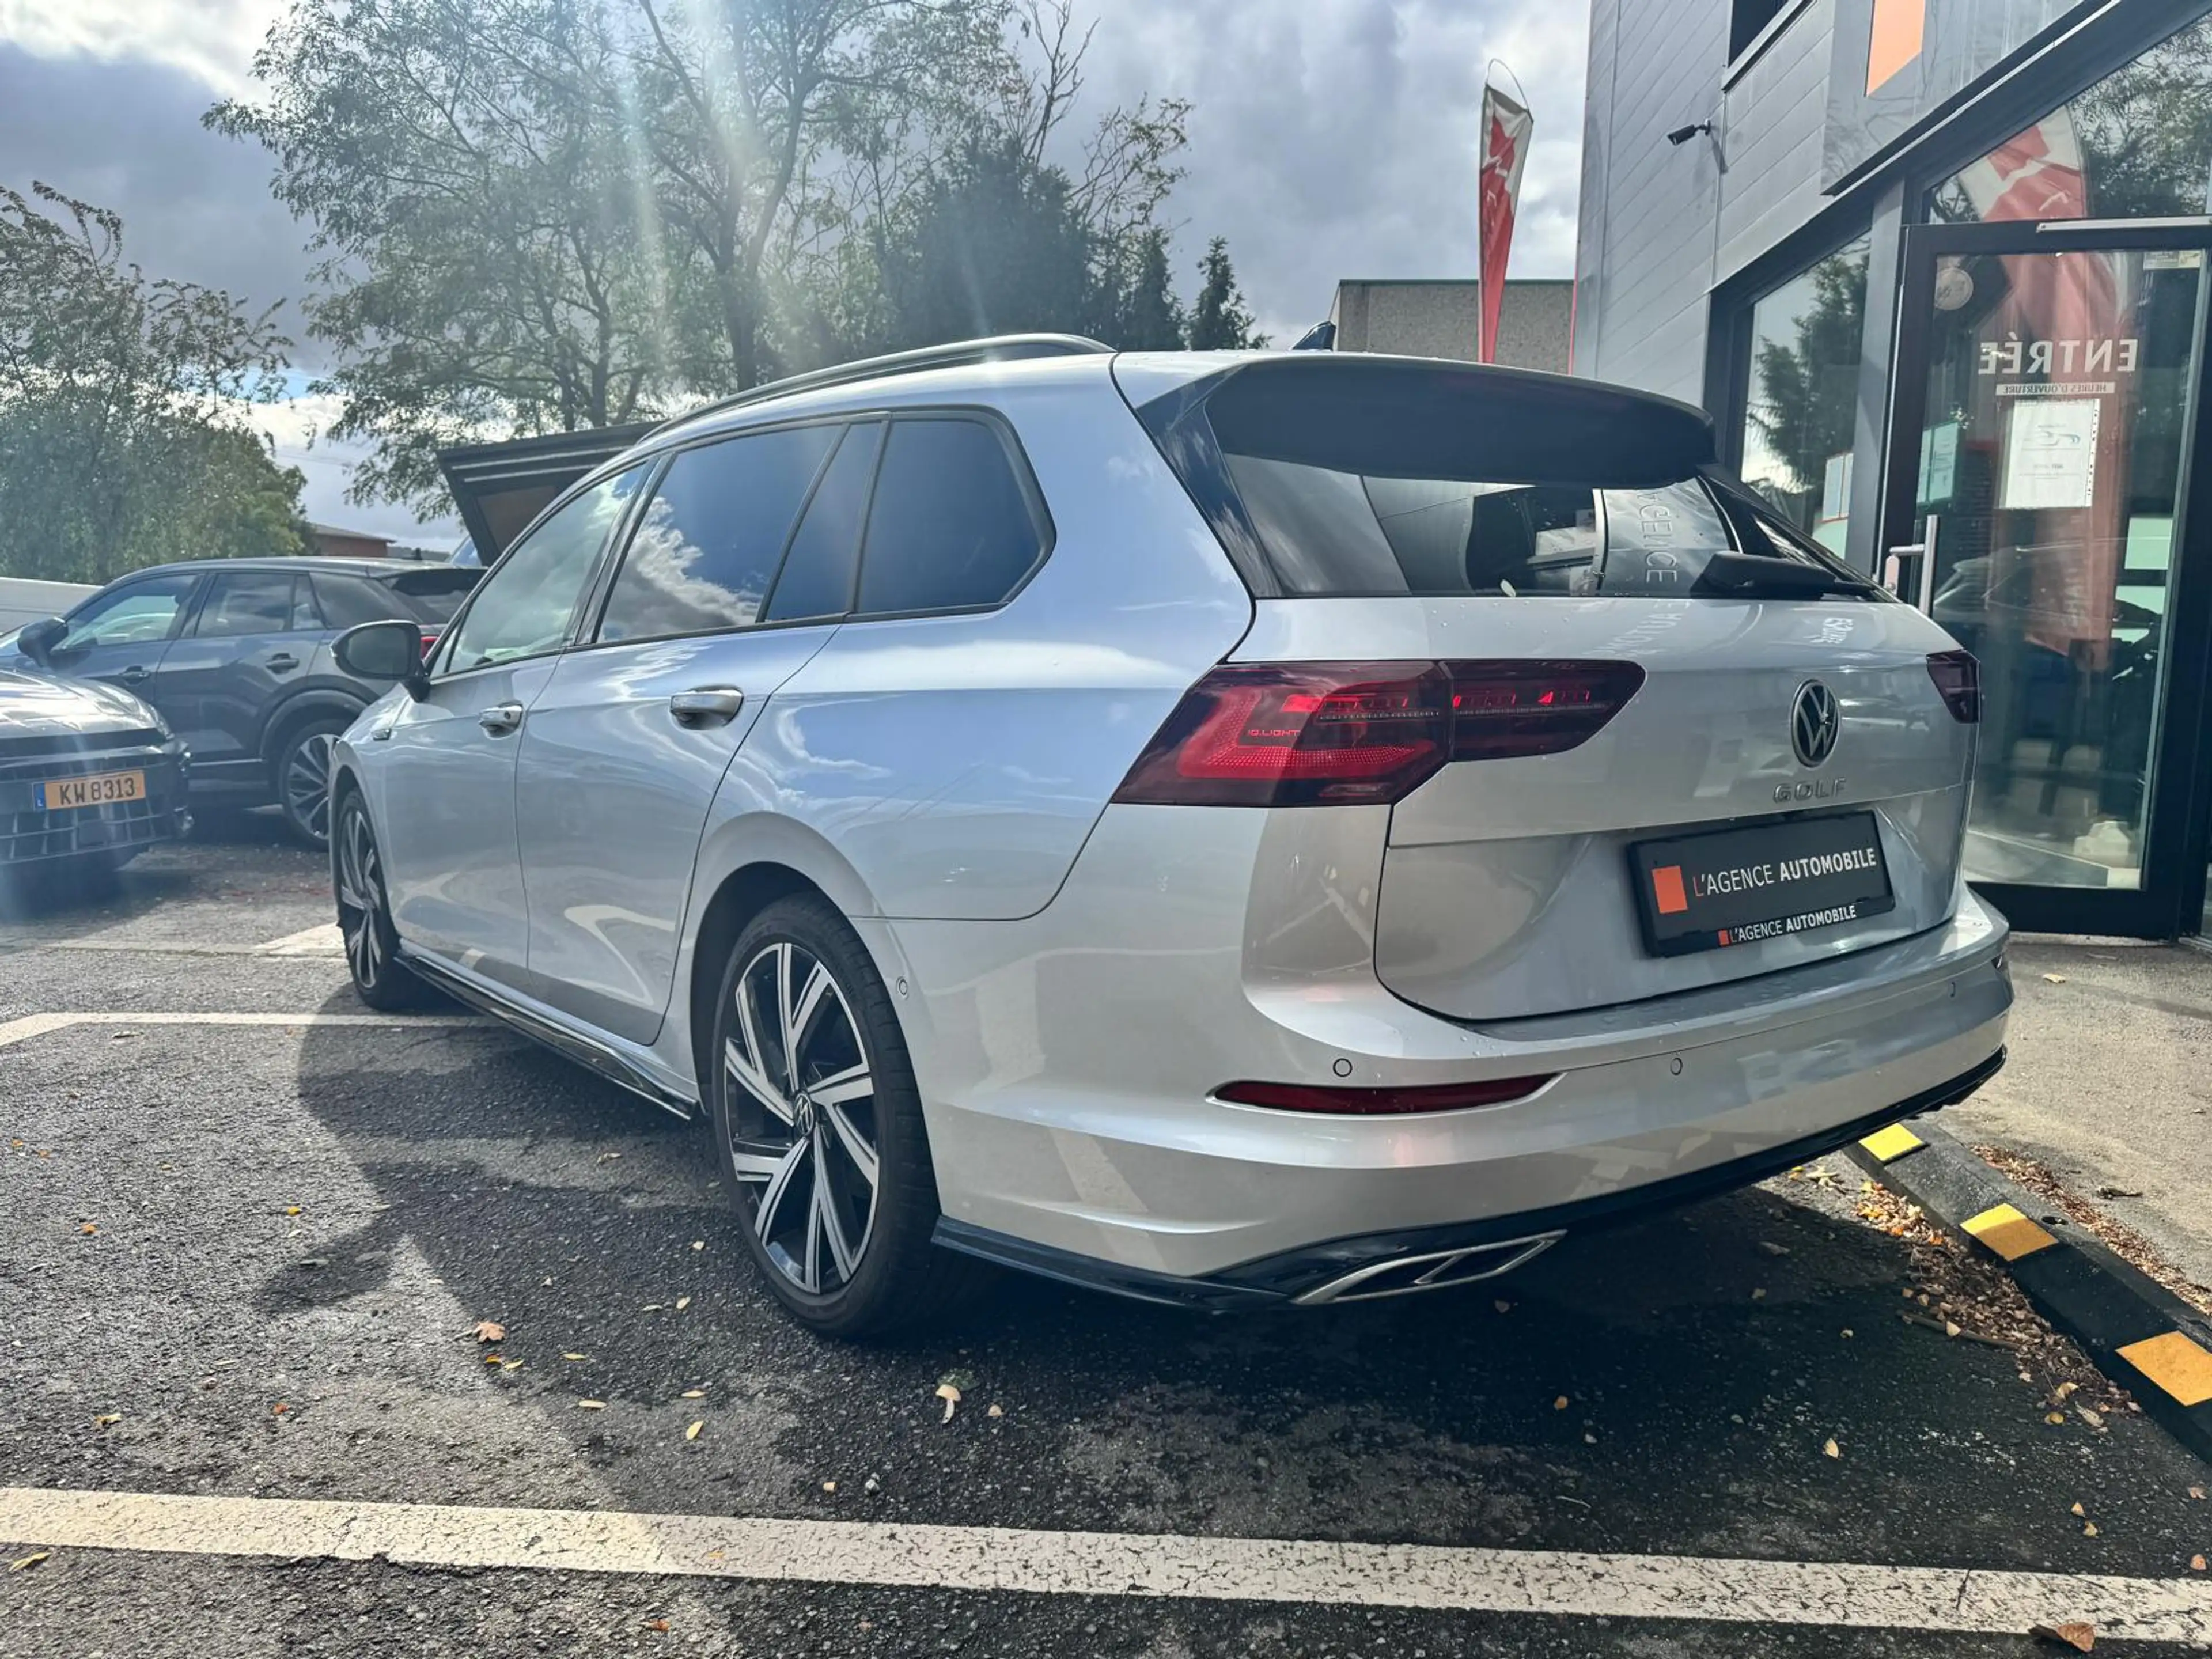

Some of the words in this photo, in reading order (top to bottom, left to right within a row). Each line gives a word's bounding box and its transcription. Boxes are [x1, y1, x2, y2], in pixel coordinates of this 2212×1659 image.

[59, 782, 85, 805] KW
[90, 777, 135, 801] 8313
[1773, 777, 1846, 803] GOLF
[1692, 864, 1776, 897] L'AGENCE
[1780, 847, 1877, 882] AUTOMOBILE
[1729, 920, 1783, 944] L'AGENCE
[1786, 904, 1858, 933] AUTOMOBILE
